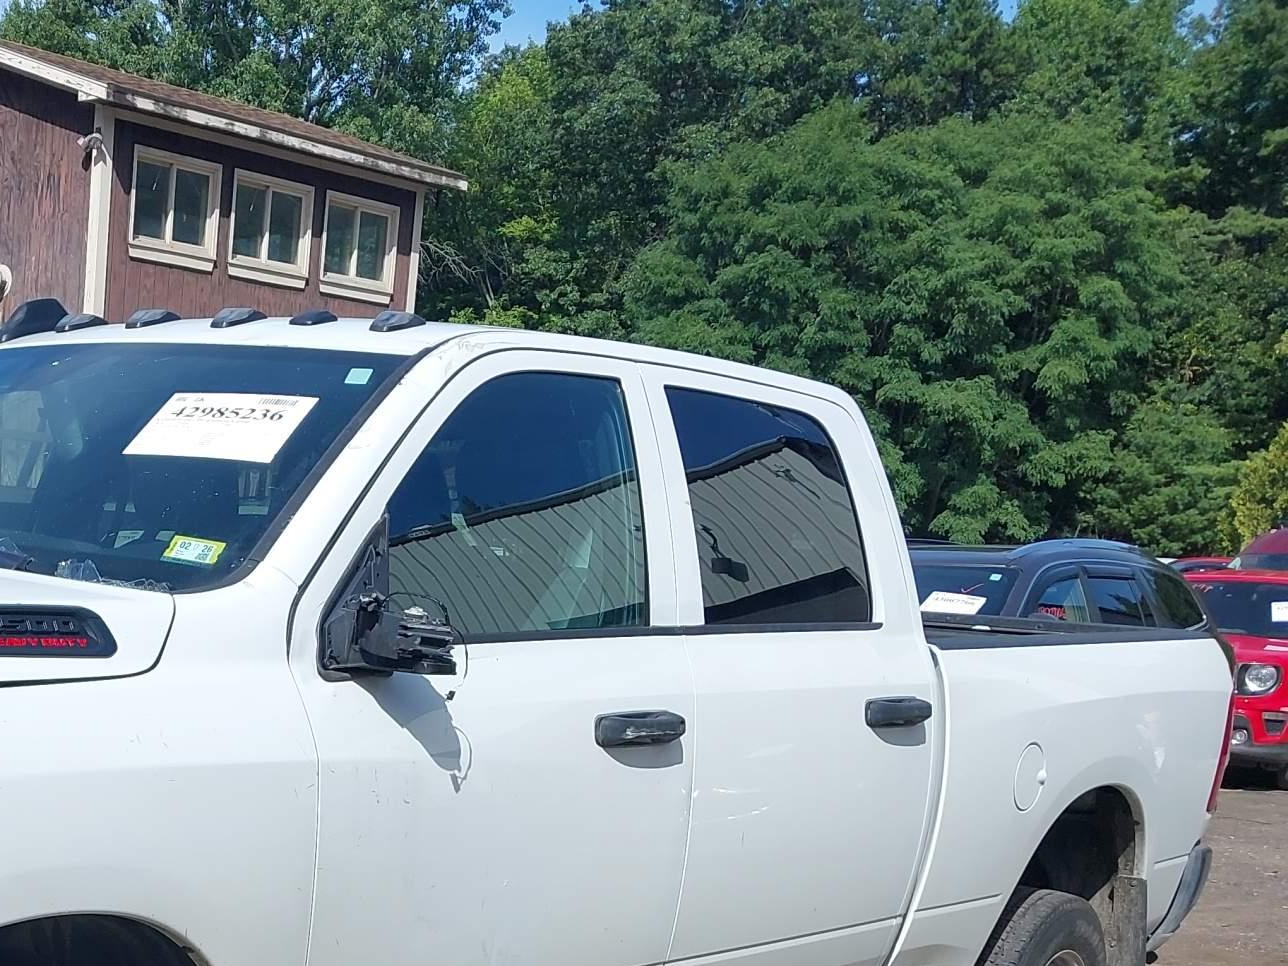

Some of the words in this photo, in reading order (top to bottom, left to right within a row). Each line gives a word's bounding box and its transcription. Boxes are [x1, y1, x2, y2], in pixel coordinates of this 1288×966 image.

[171, 406, 288, 423] 42985236
[179, 541, 192, 551] 02
[201, 544, 214, 553] 26
